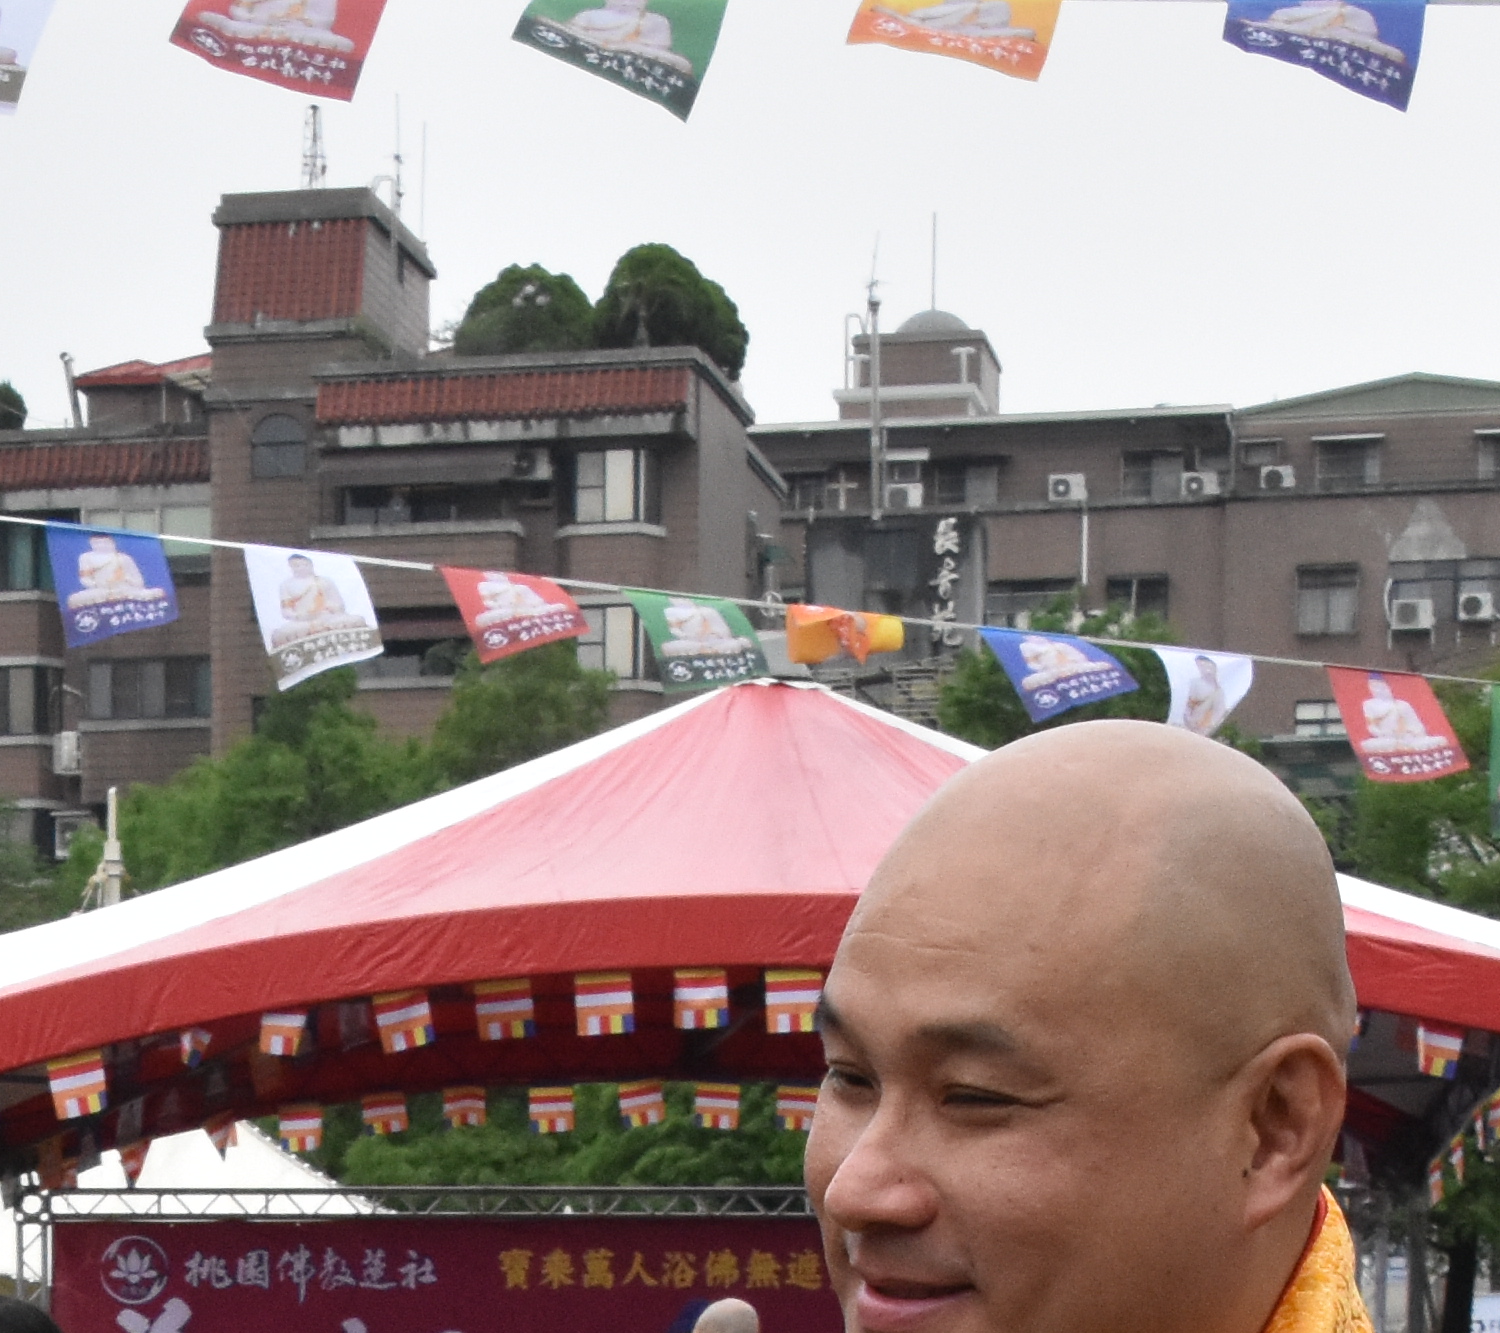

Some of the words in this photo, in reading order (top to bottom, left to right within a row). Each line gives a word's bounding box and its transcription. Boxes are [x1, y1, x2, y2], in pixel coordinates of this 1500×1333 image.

[183, 1243, 439, 1303] 桃園佛教蓮社
